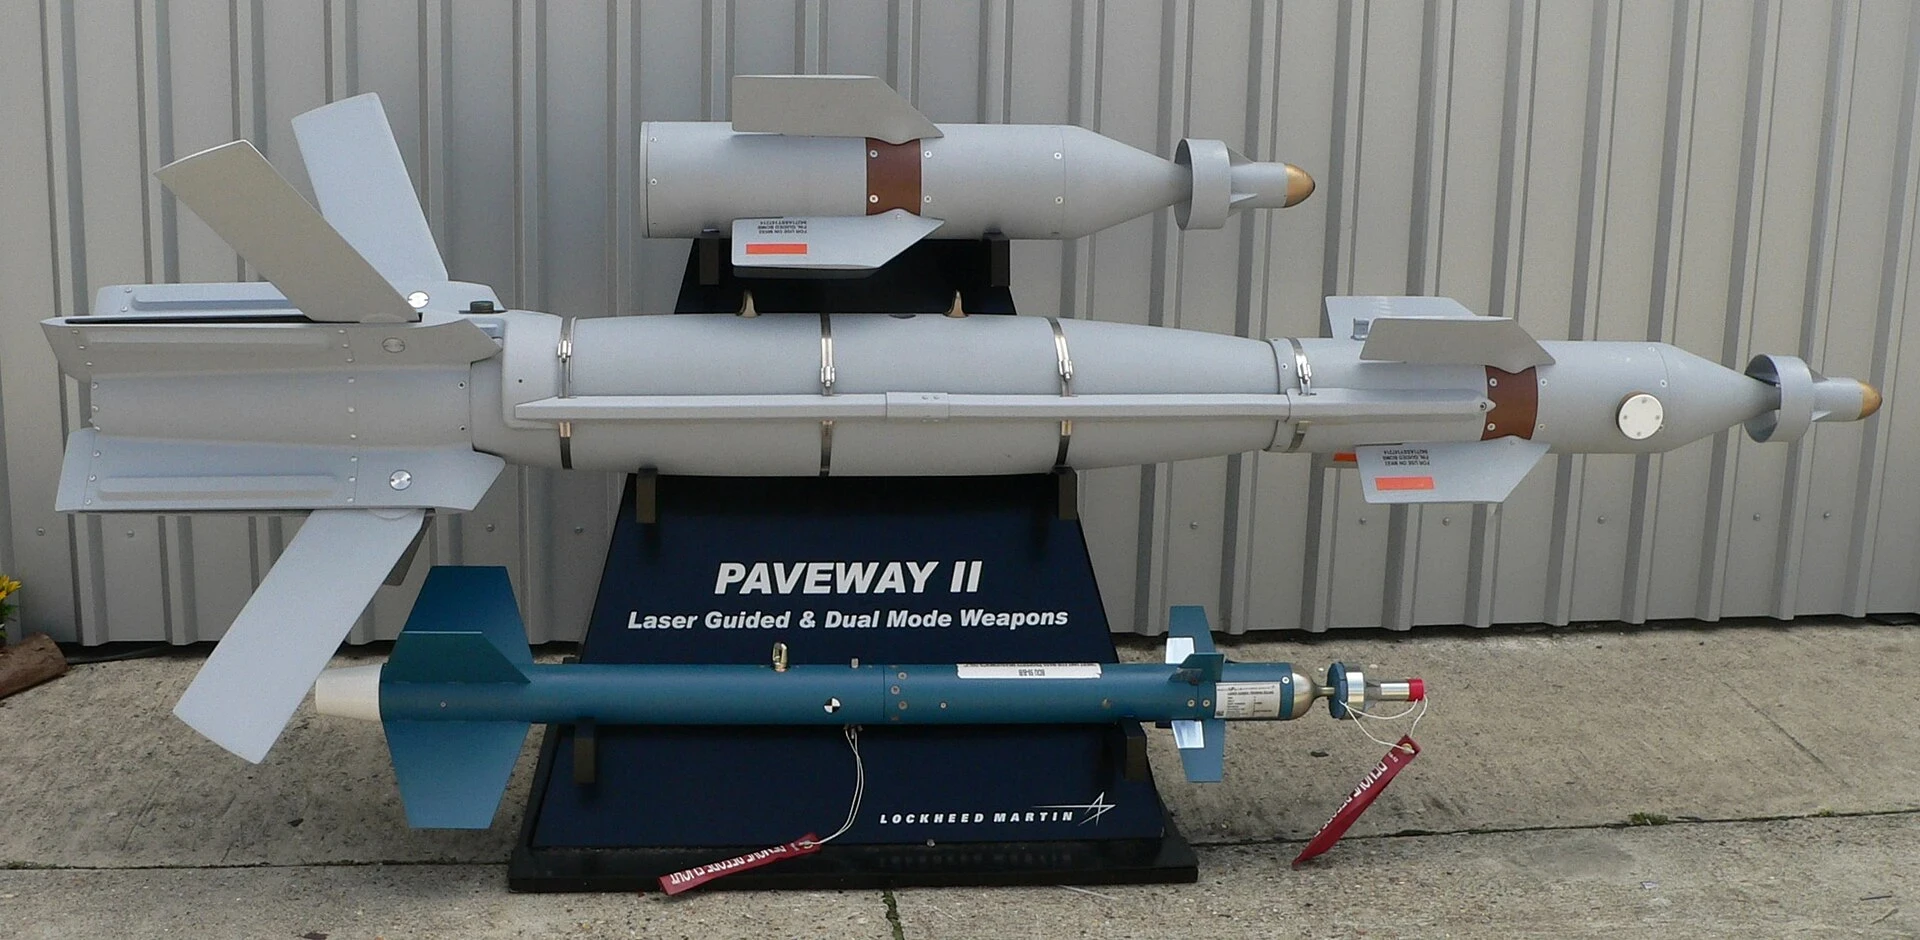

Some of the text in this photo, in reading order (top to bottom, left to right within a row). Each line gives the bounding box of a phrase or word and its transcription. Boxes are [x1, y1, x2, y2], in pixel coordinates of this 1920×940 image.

[715, 561, 983, 595] PAVEWAY II
[627, 608, 1069, 631] Laser Guided & Dual Mode Weapons
[879, 811, 1074, 824] LOCKHEED MARTIN
